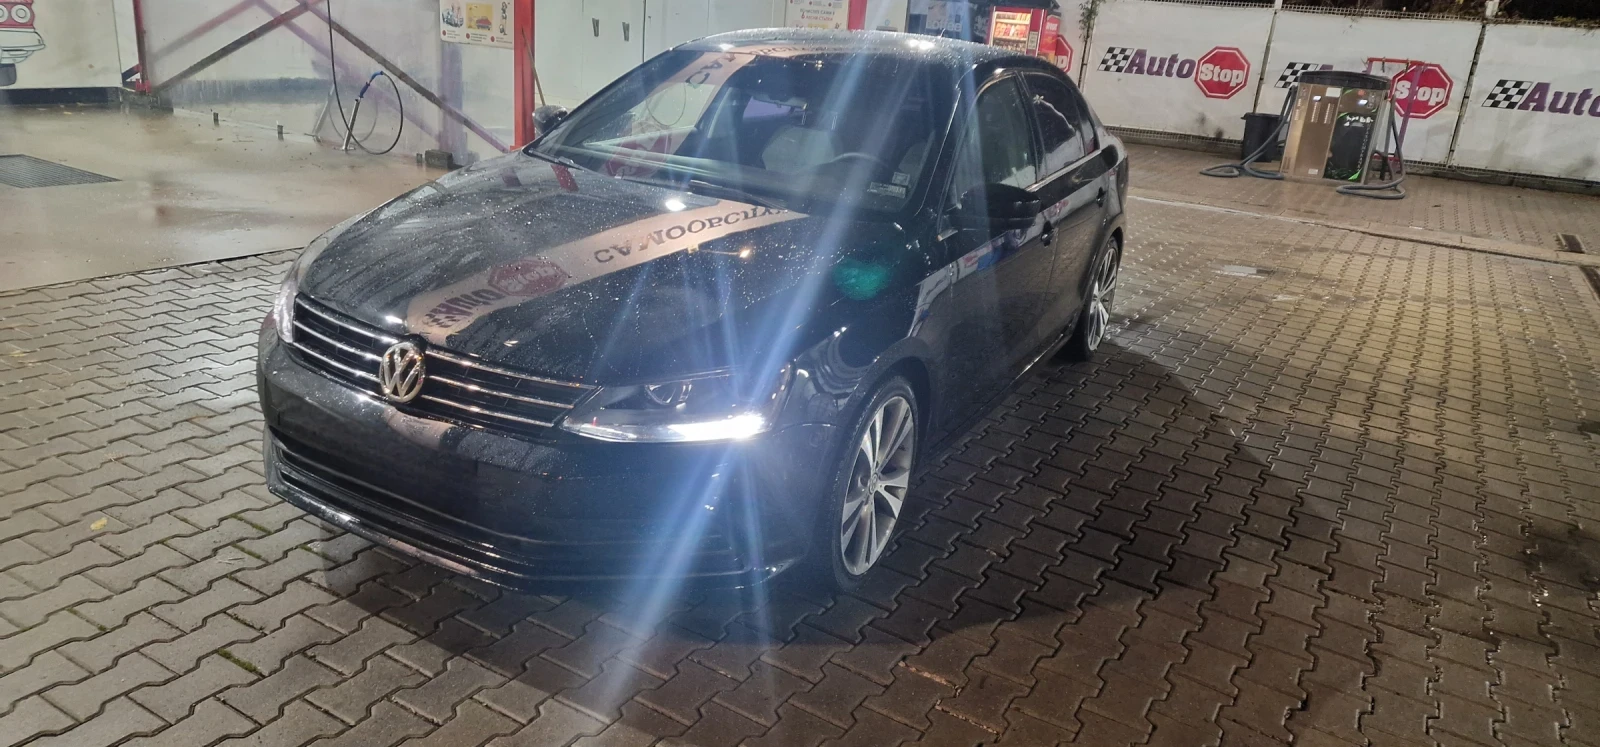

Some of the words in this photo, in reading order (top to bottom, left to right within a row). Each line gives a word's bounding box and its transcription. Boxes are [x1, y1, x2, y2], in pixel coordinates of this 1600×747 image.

[1123, 48, 1197, 79] Auto
[1200, 63, 1244, 87] Stop
[1396, 80, 1446, 106] Sop
